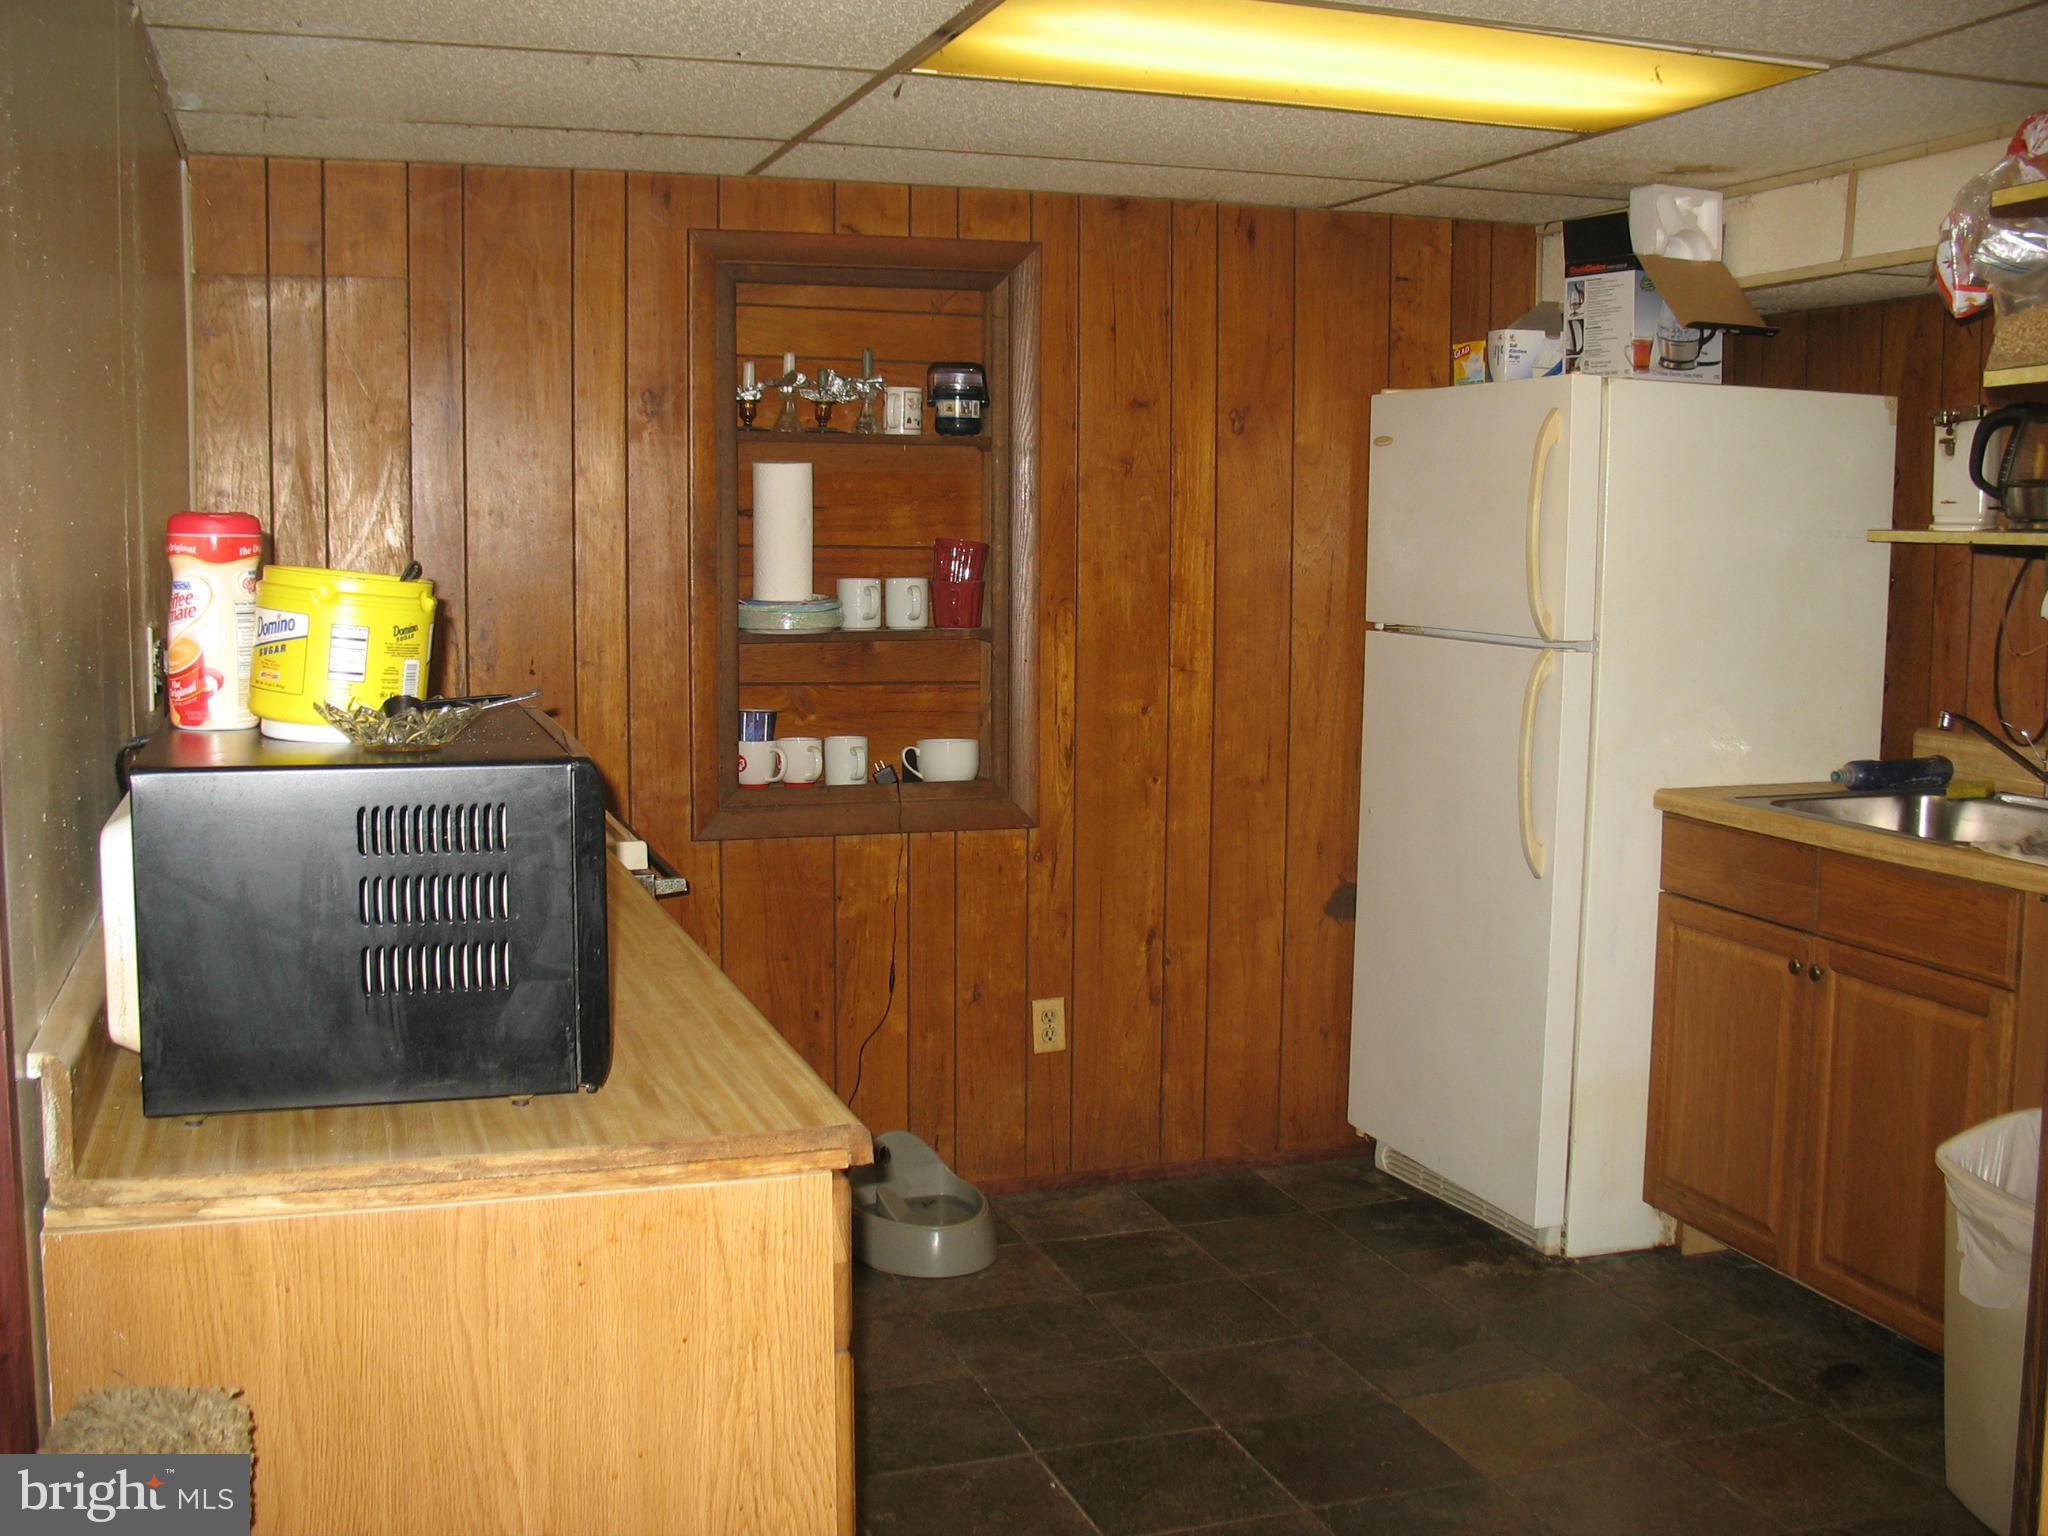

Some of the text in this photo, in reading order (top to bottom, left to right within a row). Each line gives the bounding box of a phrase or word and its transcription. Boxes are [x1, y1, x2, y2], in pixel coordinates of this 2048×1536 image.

[168, 543, 197, 554] Original
[239, 545, 252, 556] The
[257, 615, 296, 637] Domino
[393, 624, 419, 637] Domino
[259, 644, 287, 656] SUGAR
[171, 680, 181, 688] The
